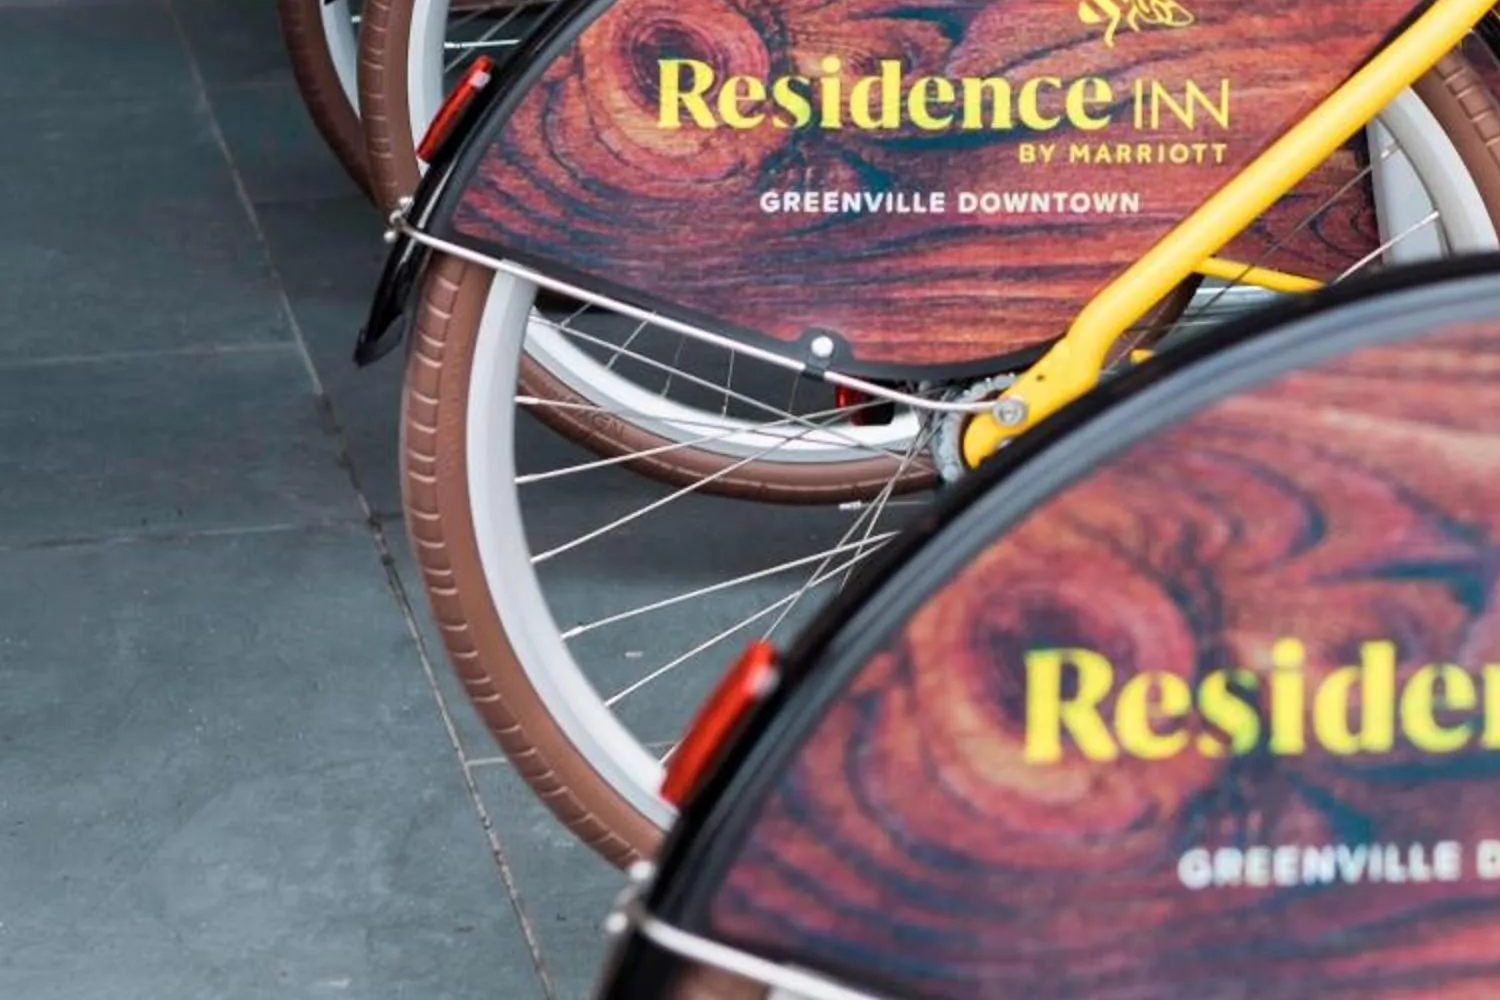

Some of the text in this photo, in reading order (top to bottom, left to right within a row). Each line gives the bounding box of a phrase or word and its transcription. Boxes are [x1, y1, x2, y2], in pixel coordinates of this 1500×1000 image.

[656, 56, 1229, 131] Residence INN
[1018, 142, 1227, 165] BY MARRIOTT
[759, 191, 1140, 214] GREENVILLE DOWNTOWN
[1176, 840, 1462, 889] GREENVILLE
